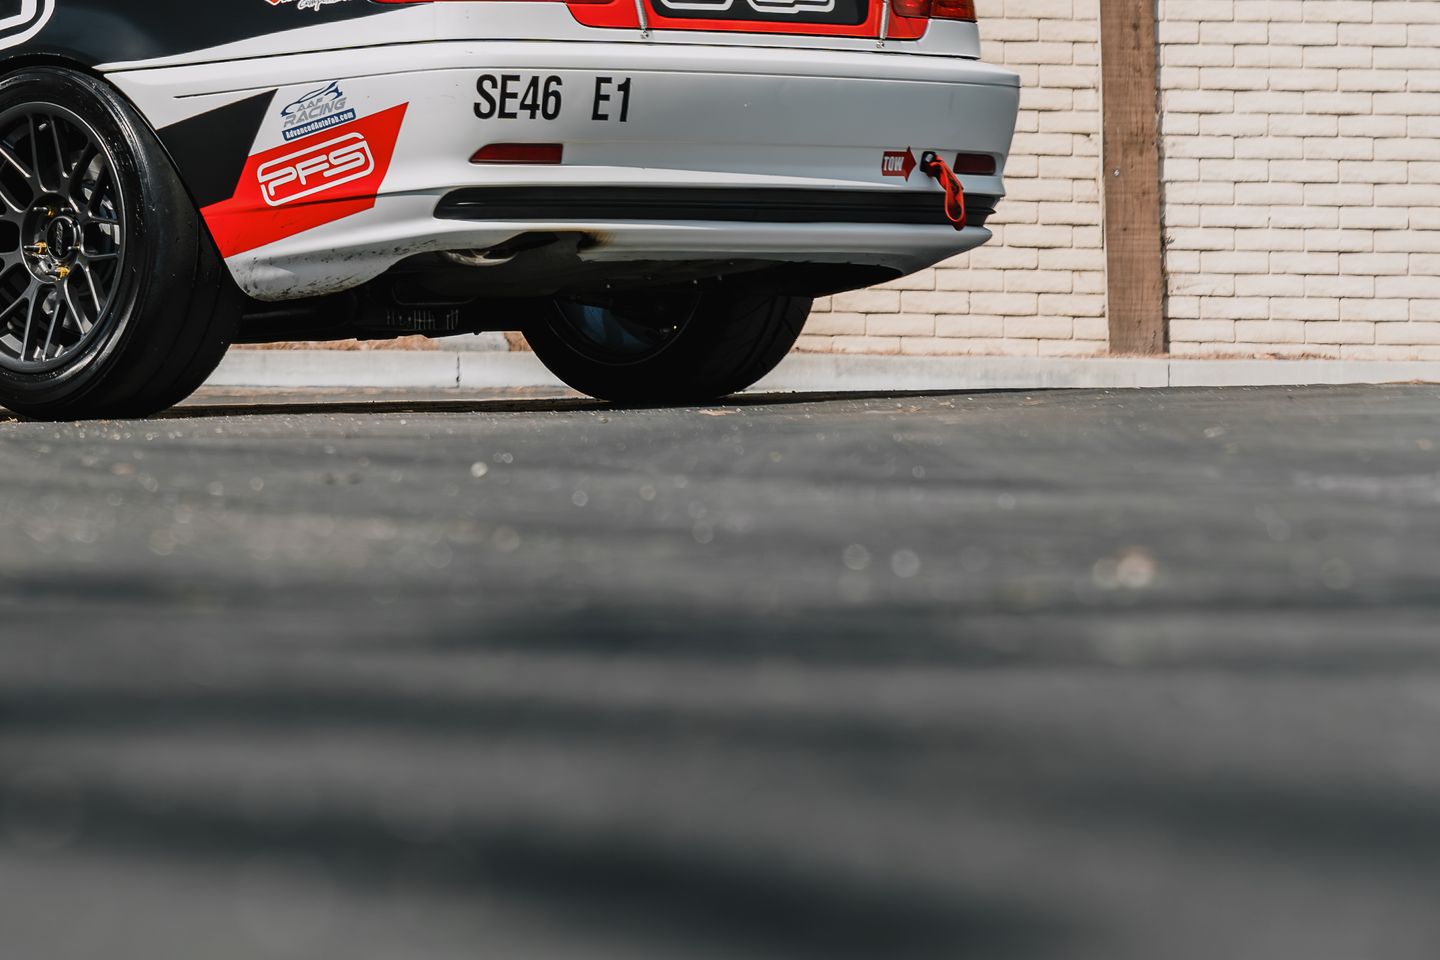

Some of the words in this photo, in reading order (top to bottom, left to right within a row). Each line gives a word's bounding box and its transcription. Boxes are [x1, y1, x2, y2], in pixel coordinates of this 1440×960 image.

[283, 97, 347, 128] RACING
[296, 97, 324, 113] AAF
[473, 74, 563, 120] SE46
[591, 76, 632, 122] E1
[285, 111, 354, 140] AdvancedAutoFab.com
[257, 140, 367, 196] PFS
[883, 156, 905, 171] TOW
